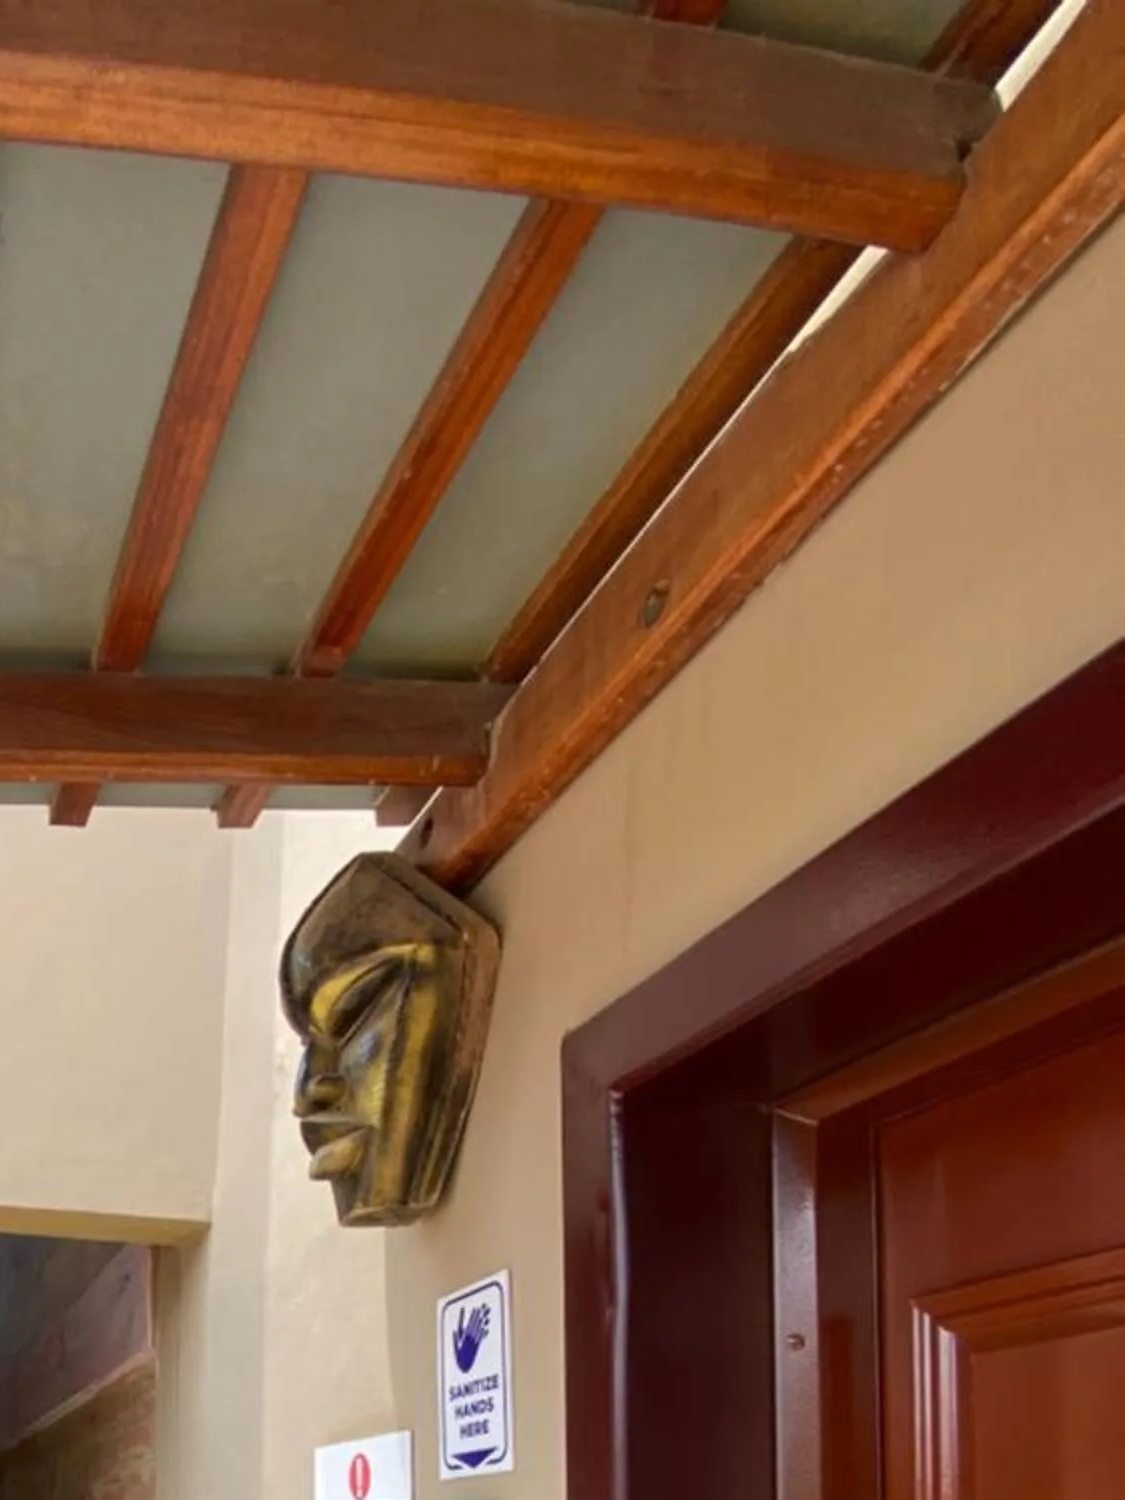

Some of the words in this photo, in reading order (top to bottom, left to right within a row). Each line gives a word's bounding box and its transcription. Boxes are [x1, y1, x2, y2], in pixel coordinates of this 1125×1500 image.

[449, 1374, 499, 1401] SANITIZE
[454, 1397, 494, 1418] HANDS
[459, 1419, 490, 1439] HERE
